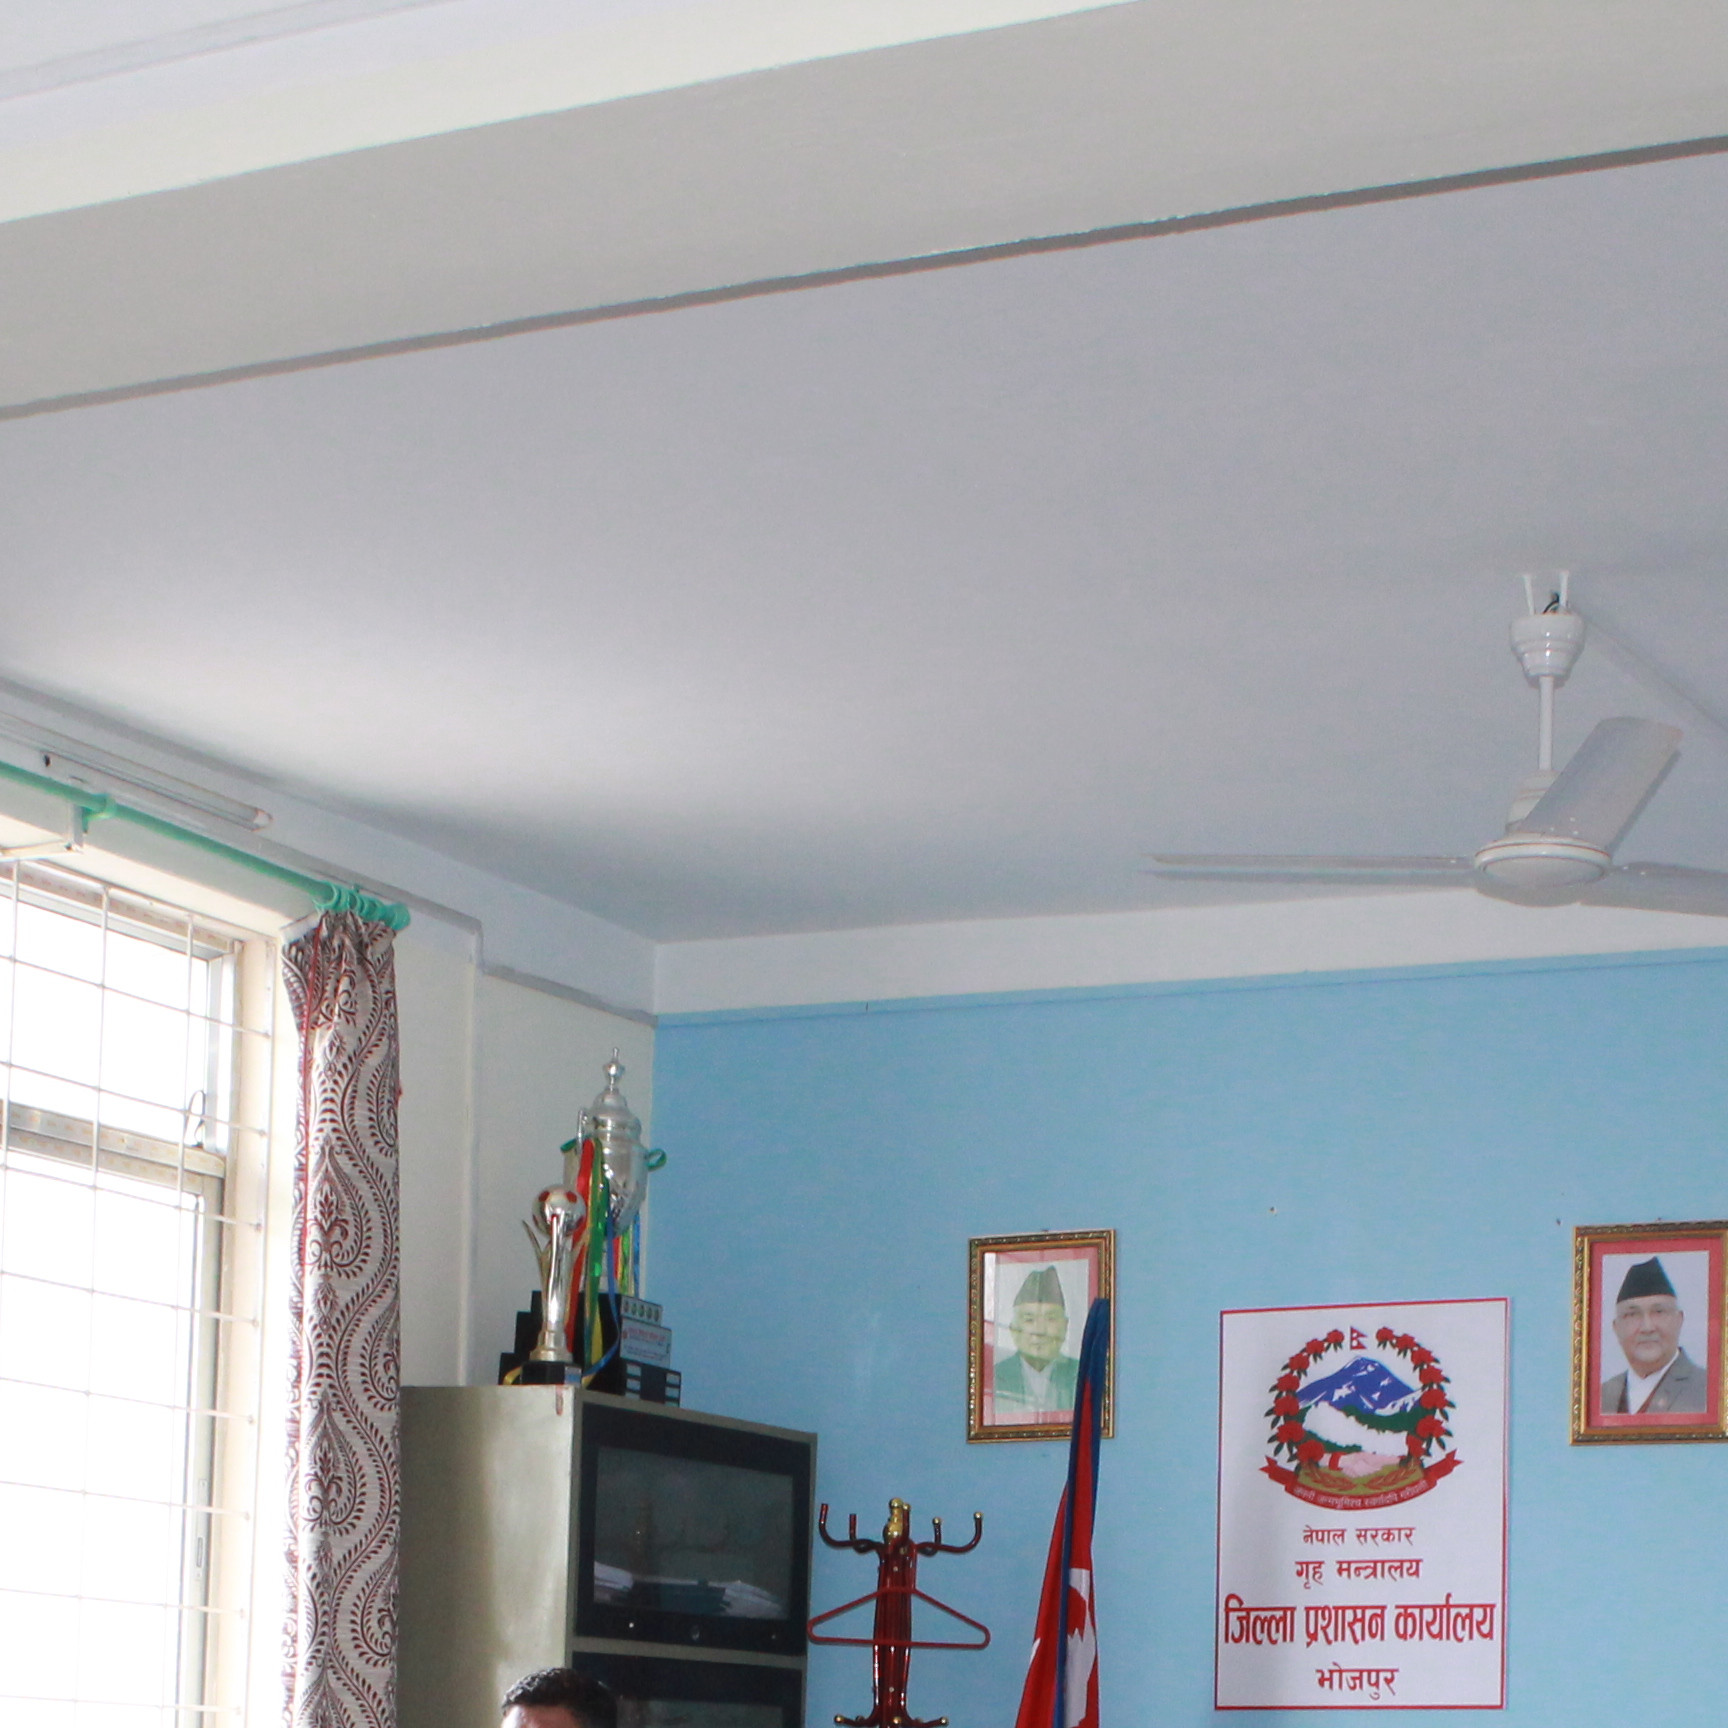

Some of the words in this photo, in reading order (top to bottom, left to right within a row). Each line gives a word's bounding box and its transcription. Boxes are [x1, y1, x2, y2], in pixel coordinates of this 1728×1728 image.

[1303, 1525, 1347, 1544] नेपाल
[1356, 1527, 1415, 1544] सरकार
[1295, 1560, 1324, 1590] गृह
[1337, 1558, 1423, 1581] मन्त्रालय
[1224, 1594, 1295, 1644] जिल्ला
[1305, 1605, 1386, 1648] प्रशासन
[1395, 1593, 1495, 1642] कार्यालय
[1317, 1663, 1399, 1699] भोजपुर
